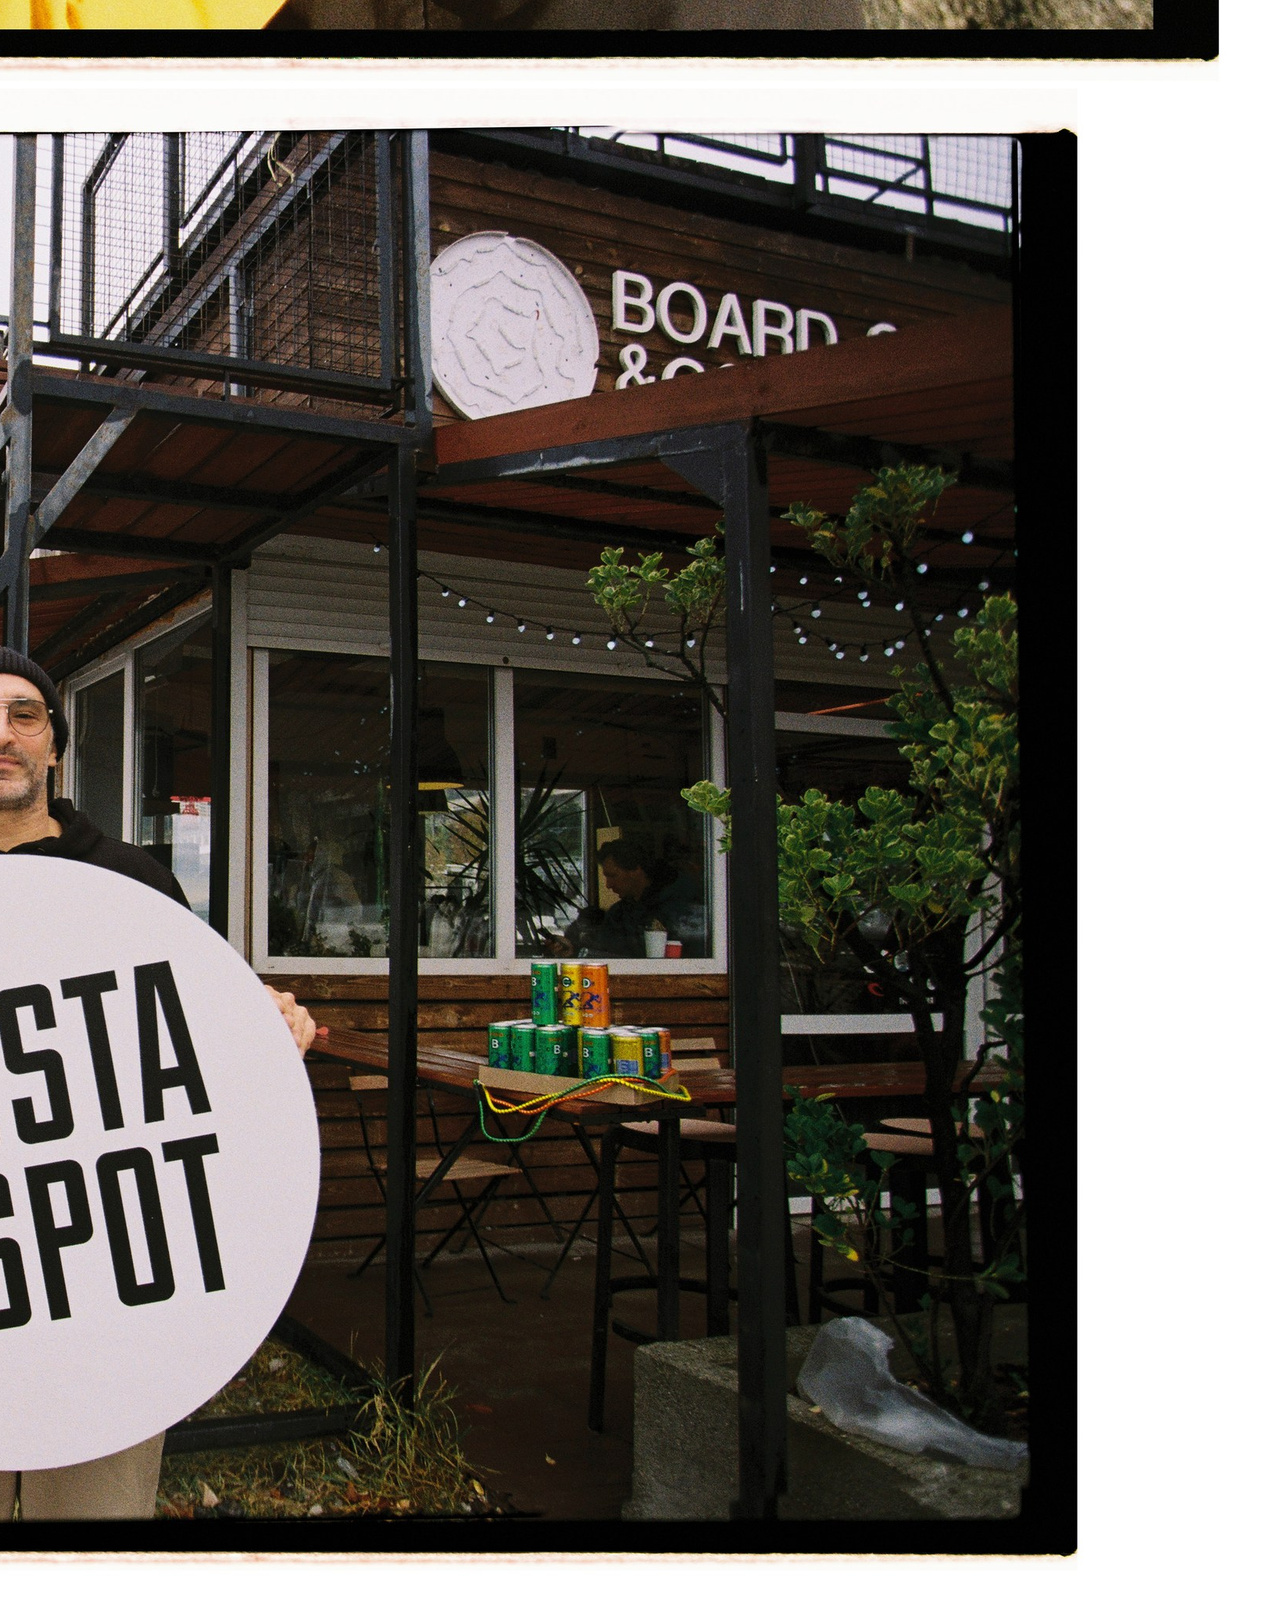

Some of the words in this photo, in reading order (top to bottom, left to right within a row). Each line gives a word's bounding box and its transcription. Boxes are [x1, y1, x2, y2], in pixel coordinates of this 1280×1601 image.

[612, 270, 837, 357] BOARD
[491, 1038, 499, 1049] B
[553, 1044, 561, 1055] B
[644, 1047, 654, 1058] B
